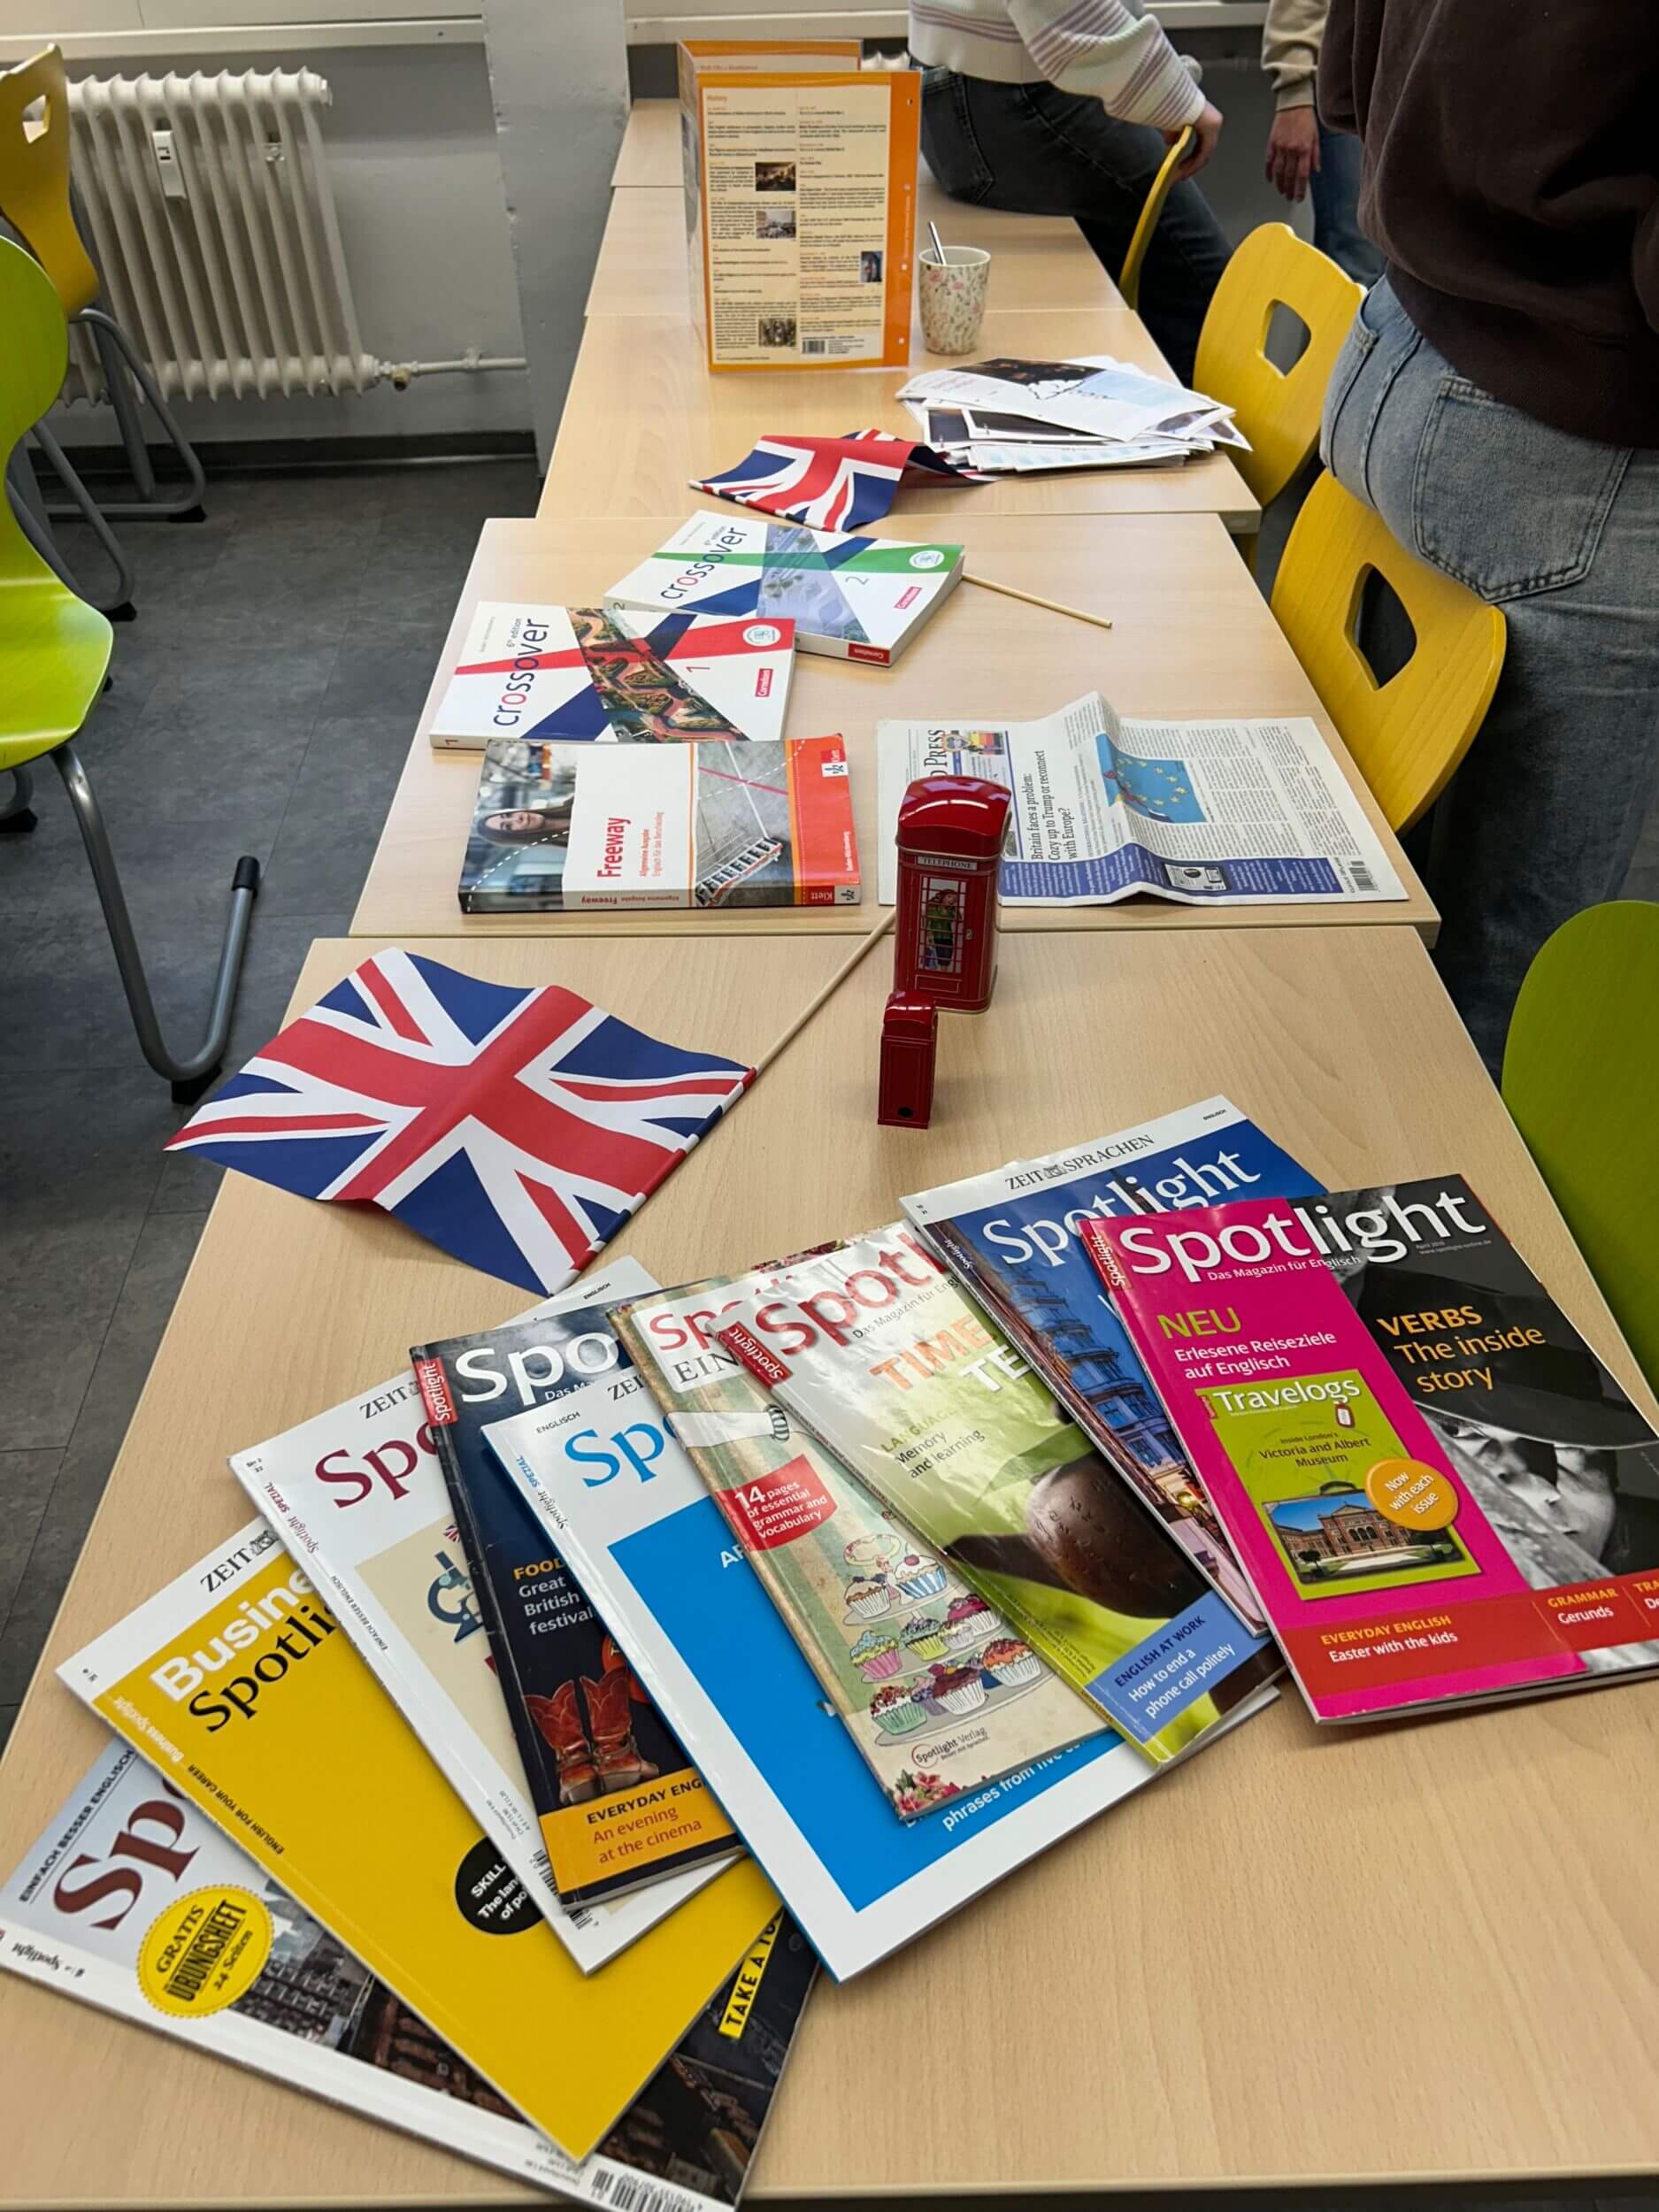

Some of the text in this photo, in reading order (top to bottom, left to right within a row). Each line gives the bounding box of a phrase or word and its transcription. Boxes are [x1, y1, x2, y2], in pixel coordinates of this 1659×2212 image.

[661, 526, 749, 601] crossover
[845, 575, 871, 587] 2
[493, 618, 550, 726] crossover
[1022, 772, 1040, 805] problem:
[1035, 749, 1063, 861] Cozy up to Trump or reconnect
[1025, 811, 1040, 832] faces
[1057, 807, 1079, 859] with Europe?
[597, 817, 631, 879] Freeway
[922, 856, 973, 869] TELEPHONE
[1027, 833, 1044, 860] Britain
[581, 895, 618, 904] Freeway
[810, 891, 833, 901] Klett
[1005, 1133, 1155, 1190] ZEIT SPRACHEN
[982, 1149, 1261, 1267] Spotlight
[1119, 1191, 1487, 1283] Spotlight
[1091, 1233, 1126, 1287] Spotlight
[1208, 1254, 1361, 1281] Das Magazin für Englisch
[649, 1301, 743, 1350] Sp
[873, 1297, 918, 1328] Magazin
[1156, 1307, 1241, 1340] NEU
[1376, 1305, 1484, 1337] VERBS
[729, 1328, 785, 1379] Spotlight
[1174, 1330, 1337, 1363] Erlesene Reiseziele
[1394, 1325, 1546, 1367] The inside
[1185, 1355, 1291, 1380] auf Englisch
[1416, 1365, 1495, 1394] story
[359, 1388, 409, 1419] ZEIT
[423, 1363, 451, 1422] Spotlight
[607, 1373, 645, 1402] ZEI
[1213, 1377, 1361, 1412] Travelogs
[535, 1410, 581, 1434] ENGLISCH
[564, 1417, 679, 1488] Sp
[894, 1429, 948, 1465] Memory
[907, 1457, 933, 1479] and
[932, 1429, 987, 1465] learning
[1258, 1438, 1371, 1459] Victoria and Albert
[1294, 1453, 1348, 1467] Museum
[734, 1480, 801, 1509] 14 pages
[1385, 1471, 1409, 1492] Now
[1388, 1474, 1434, 1513] with each
[746, 1487, 811, 1519] of essential
[752, 1494, 828, 1532] grammar and
[1412, 1492, 1440, 1516] issue
[757, 1509, 824, 1540] vocabulary
[200, 1548, 251, 1594] ZEIT
[518, 1575, 566, 1598] Great
[524, 1592, 580, 1617] British
[1548, 1587, 1618, 1608] GRAMMAR
[1321, 1615, 1452, 1645] EVERYDAY ENGLISH
[1557, 1605, 1615, 1624] Gerunds
[1115, 1616, 1206, 1687] ENGLISH AT WORK
[1329, 1631, 1458, 1663] Easter with the kids
[188, 1605, 336, 1732] Spotli
[1127, 1648, 1196, 1704] How to end a
[1144, 1685, 1182, 1720] phone
[1178, 1670, 1200, 1693] call
[1196, 1641, 1237, 1679] politely
[916, 1726, 988, 1764] Spotlight Verlag
[187, 1763, 219, 1793] CAREER
[587, 1788, 665, 1825] EVERYDAY
[941, 1766, 1035, 1832] phrases from
[19, 1748, 134, 1902] EINFACH BESSER ENGLISCH
[251, 1824, 285, 1855] ENGLISH
[592, 1806, 680, 1844] An evening
[598, 1819, 703, 1864] at the cinema
[53, 1774, 201, 1931] Sp
[471, 1863, 507, 1898] SKILL
[477, 1894, 503, 1918] The
[501, 1901, 515, 1920] of
[726, 1955, 766, 2025] TAKE A
